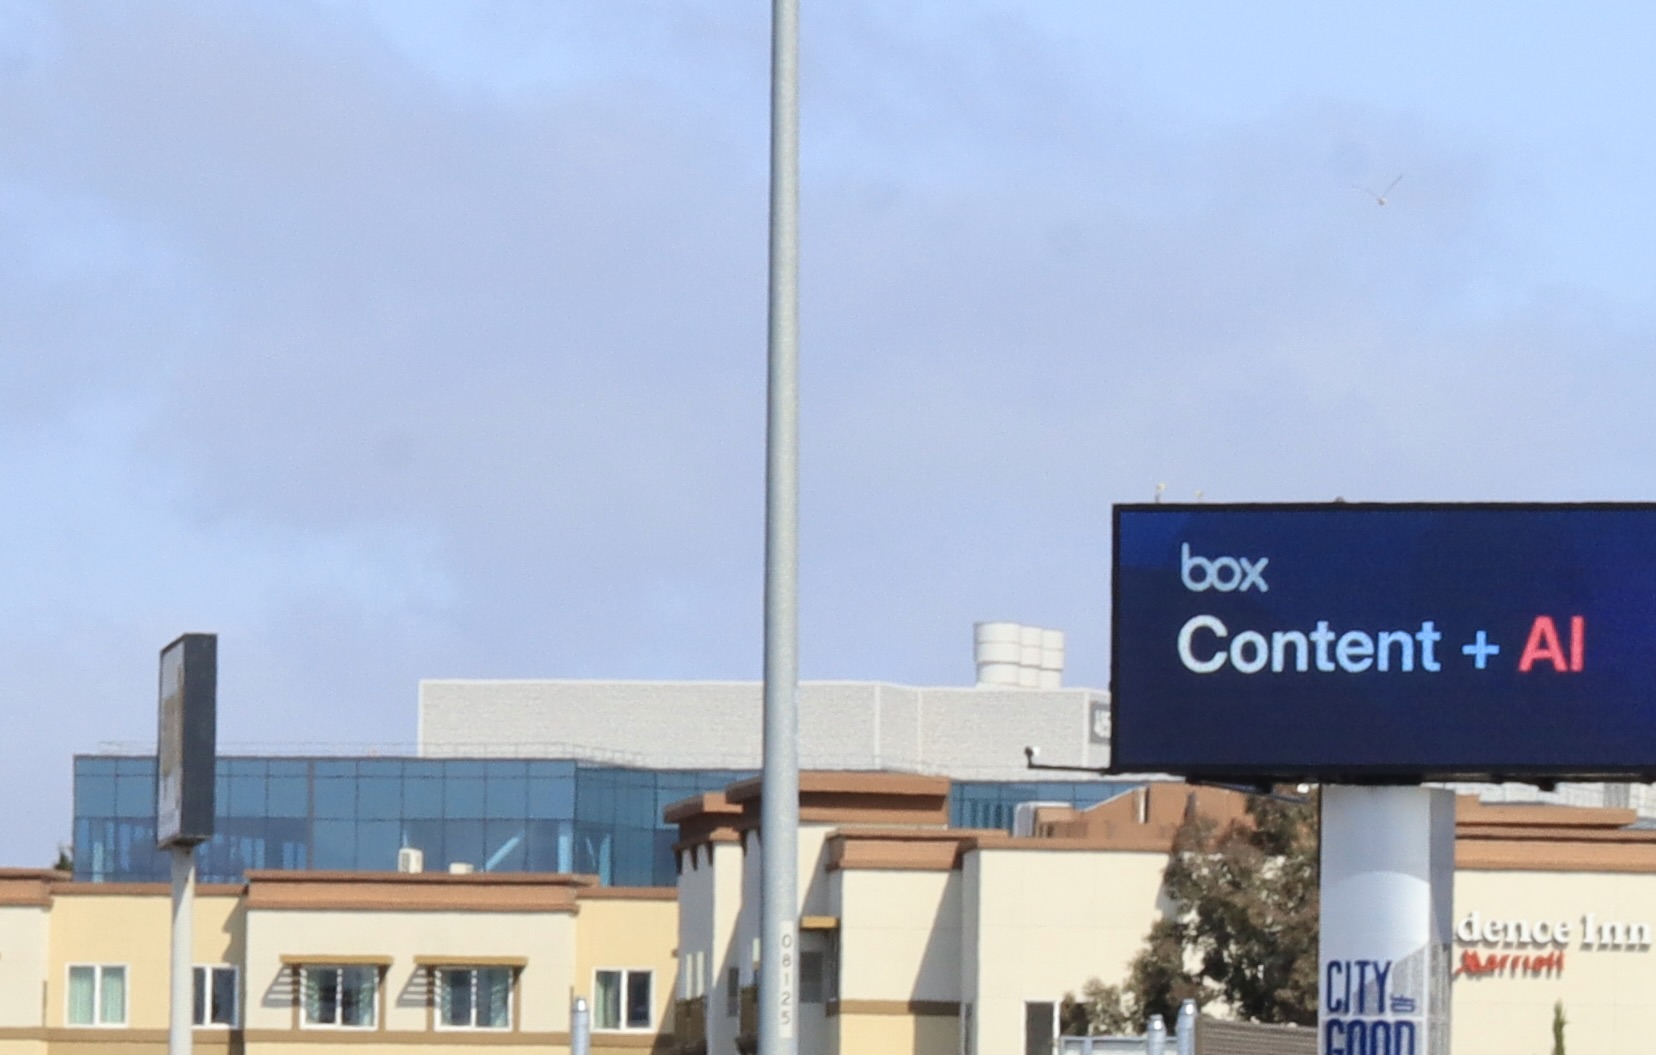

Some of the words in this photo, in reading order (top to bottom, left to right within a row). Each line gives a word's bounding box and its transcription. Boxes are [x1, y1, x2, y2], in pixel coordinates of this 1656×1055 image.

[1181, 542, 1270, 593] box
[1177, 614, 1441, 674] Content
[1462, 630, 1500, 670] +
[1517, 615, 1585, 673] AI
[1580, 912, 1652, 946] Inn
[1327, 960, 1392, 1014] CITY
[1453, 949, 1565, 975] Marriott
